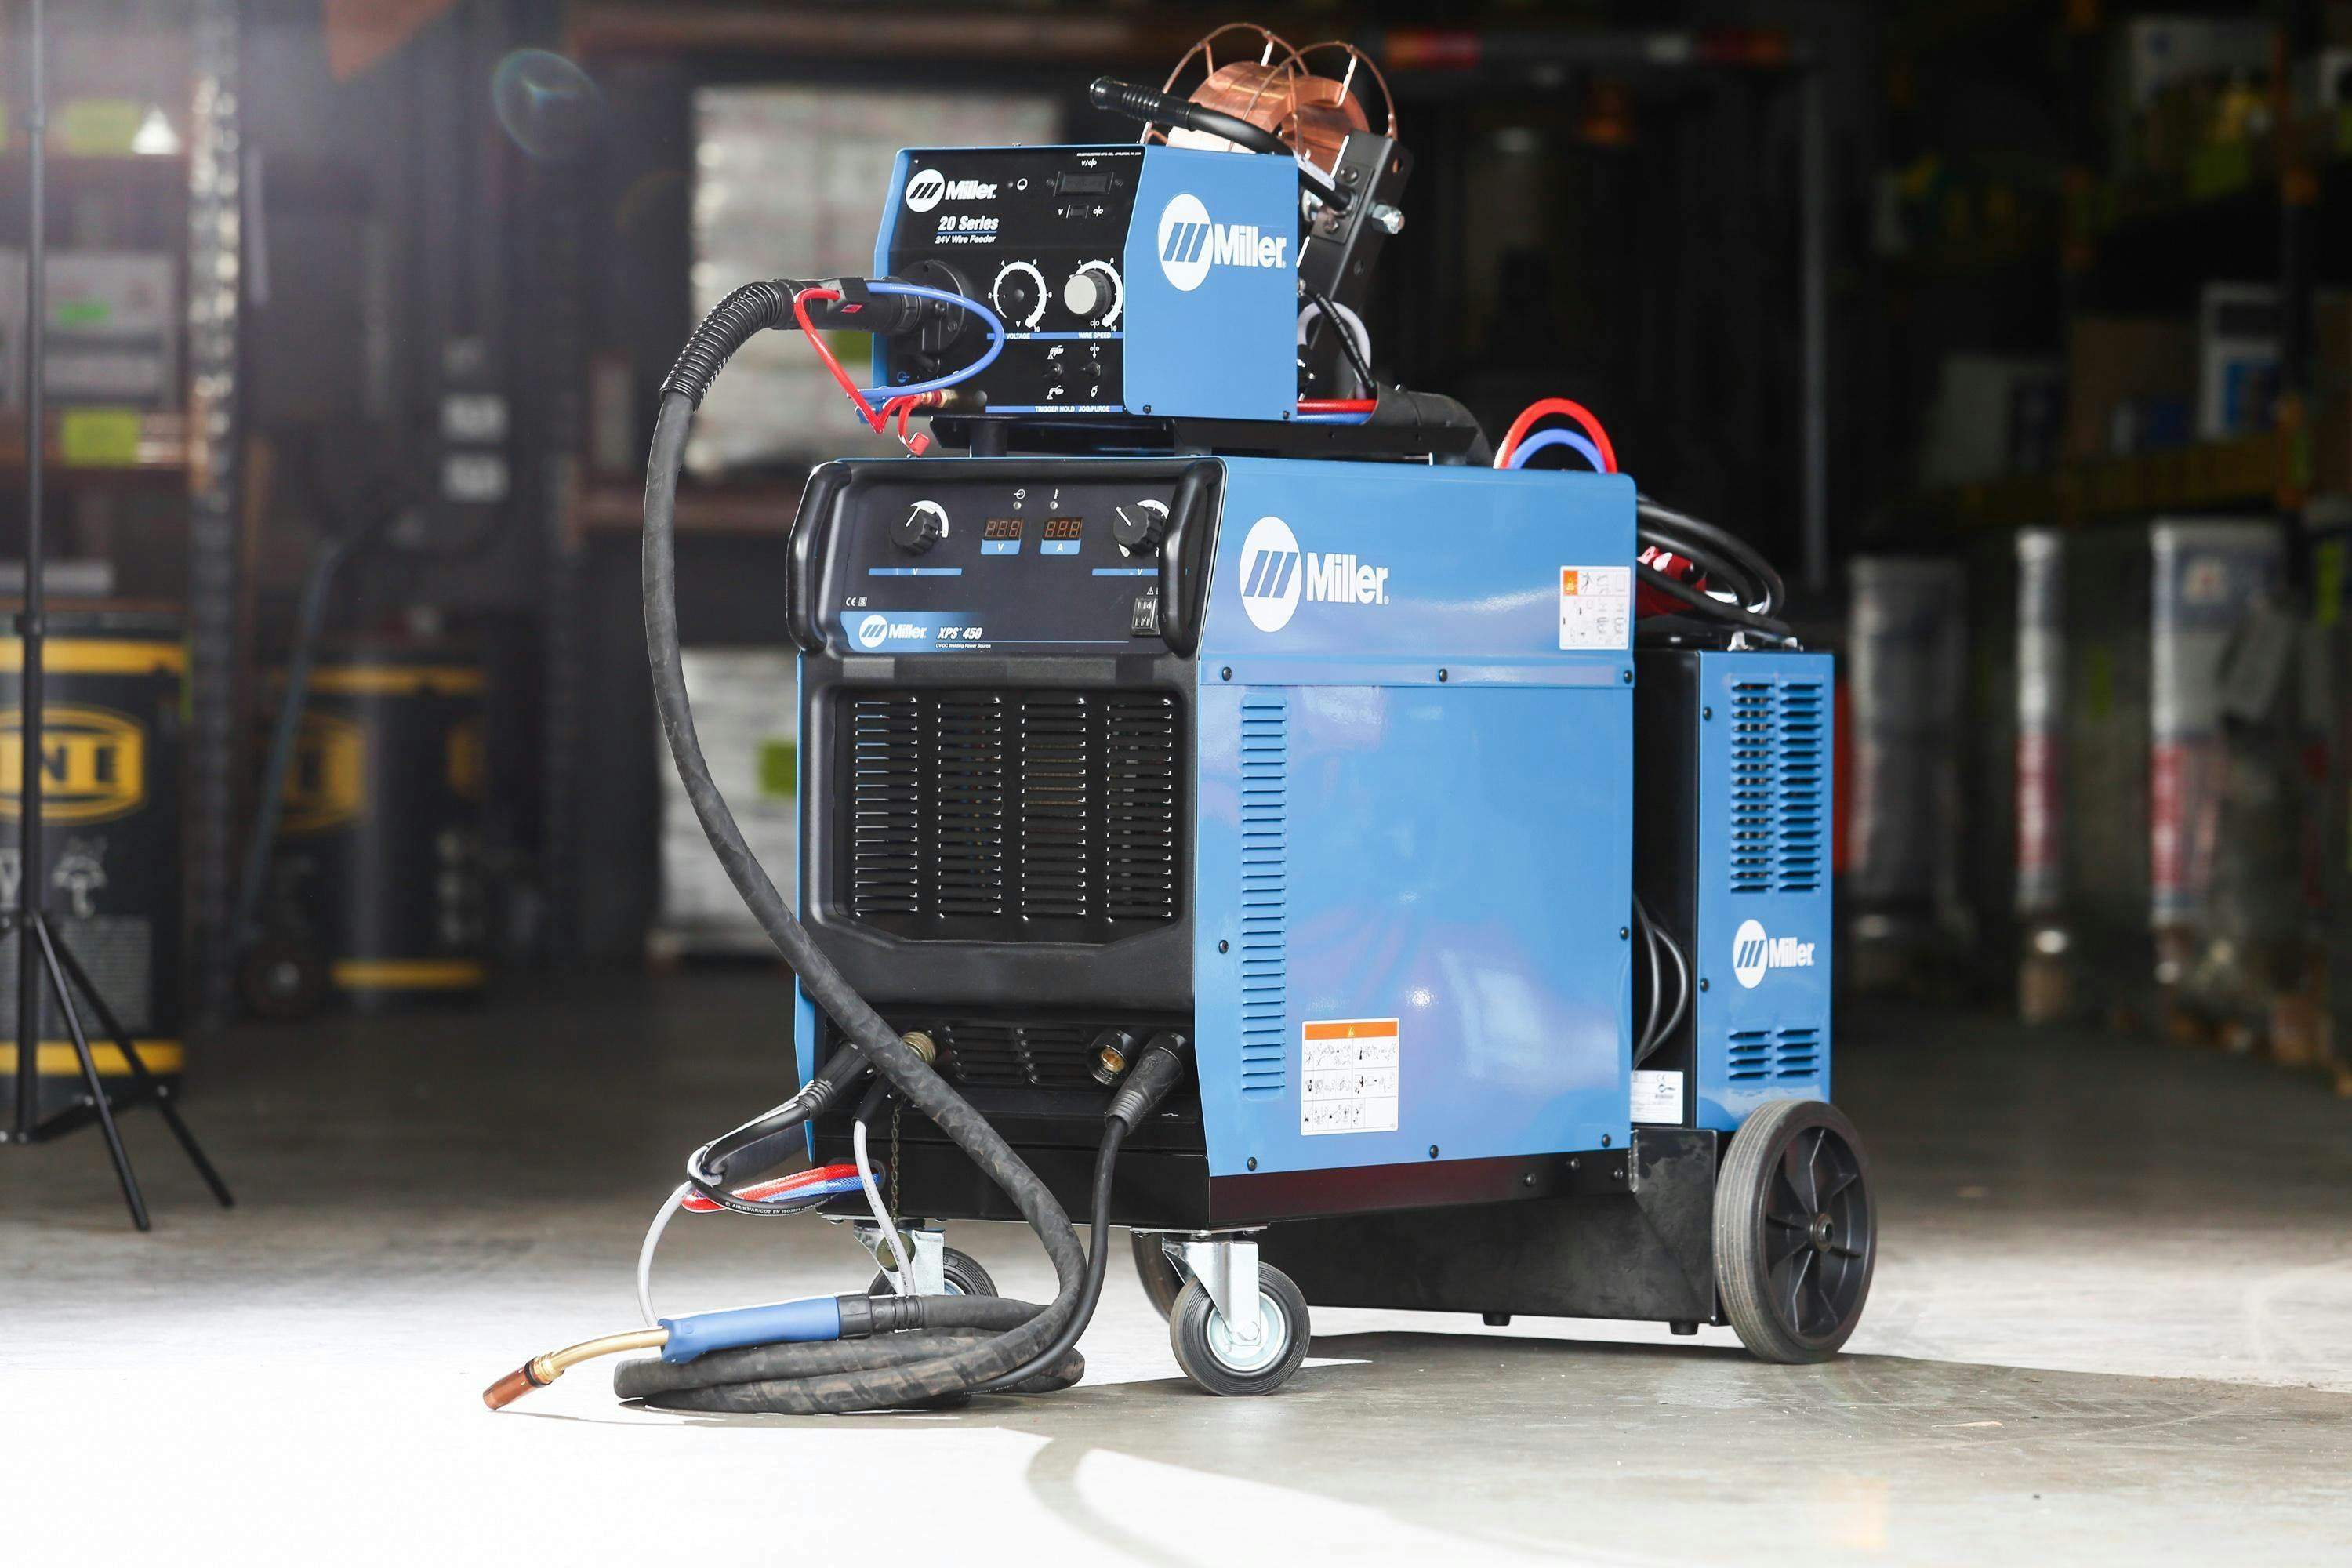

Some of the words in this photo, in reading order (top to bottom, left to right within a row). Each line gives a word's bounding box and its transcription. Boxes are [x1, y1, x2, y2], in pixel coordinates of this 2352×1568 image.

[938, 216, 956, 231] 20
[958, 215, 1000, 230] Series
[935, 235, 951, 244] 24V
[951, 235, 968, 244] Wire
[997, 543, 1004, 552] V
[1056, 543, 1064, 552] A
[963, 627, 983, 640] 450
